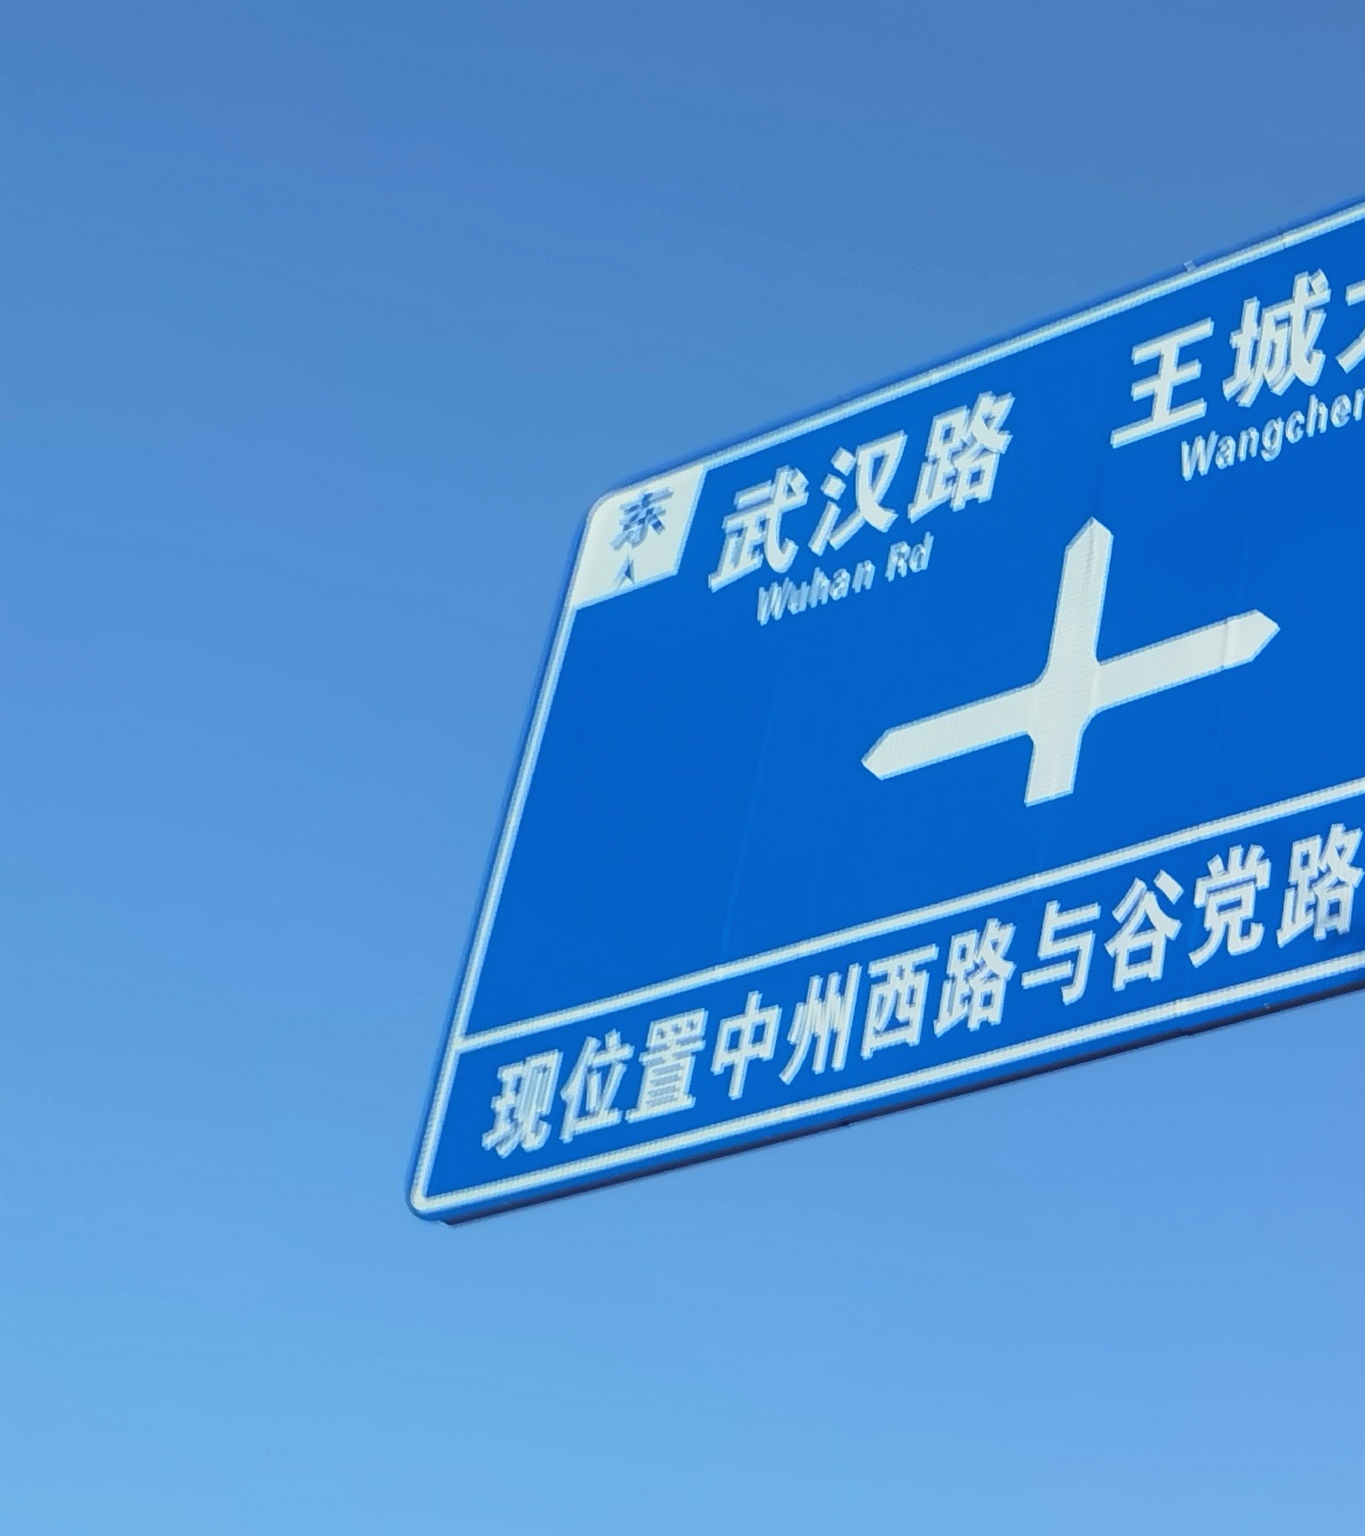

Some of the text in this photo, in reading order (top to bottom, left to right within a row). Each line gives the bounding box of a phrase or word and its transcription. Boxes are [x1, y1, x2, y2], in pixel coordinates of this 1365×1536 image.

[708, 388, 1014, 593] 武汉路
[757, 531, 934, 627] Wuhan Rd
